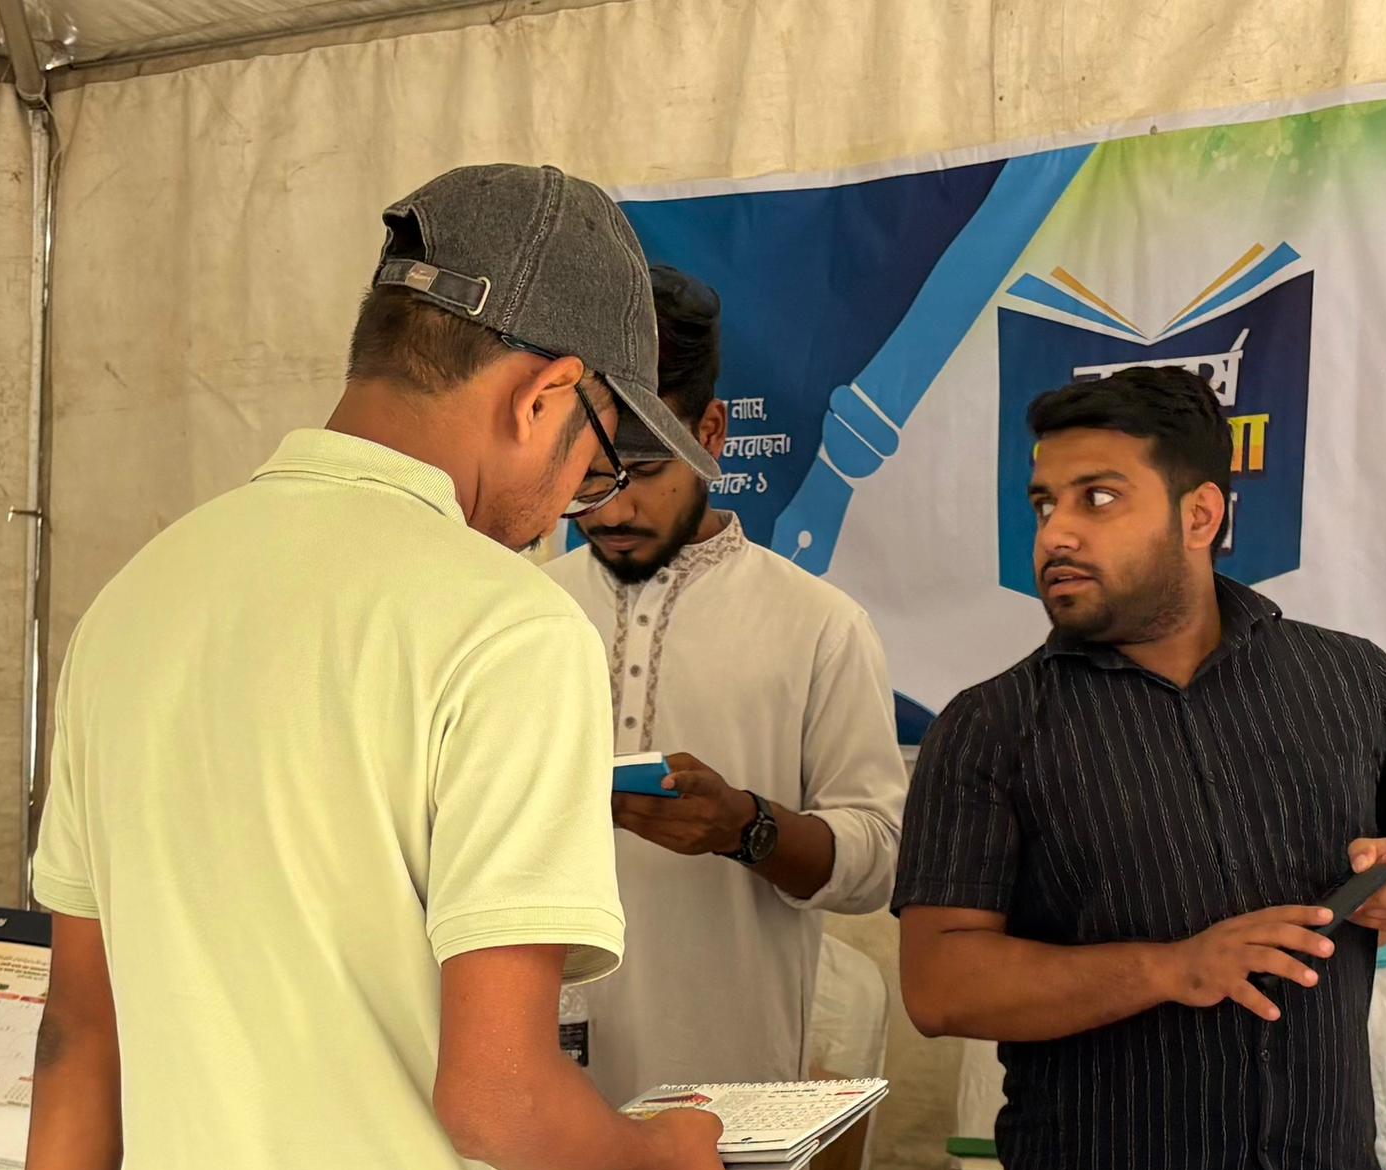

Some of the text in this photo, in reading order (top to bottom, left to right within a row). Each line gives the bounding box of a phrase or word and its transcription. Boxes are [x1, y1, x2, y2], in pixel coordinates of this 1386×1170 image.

[731, 397, 767, 421] নামে,
[709, 472, 768, 495] লাক: ১
